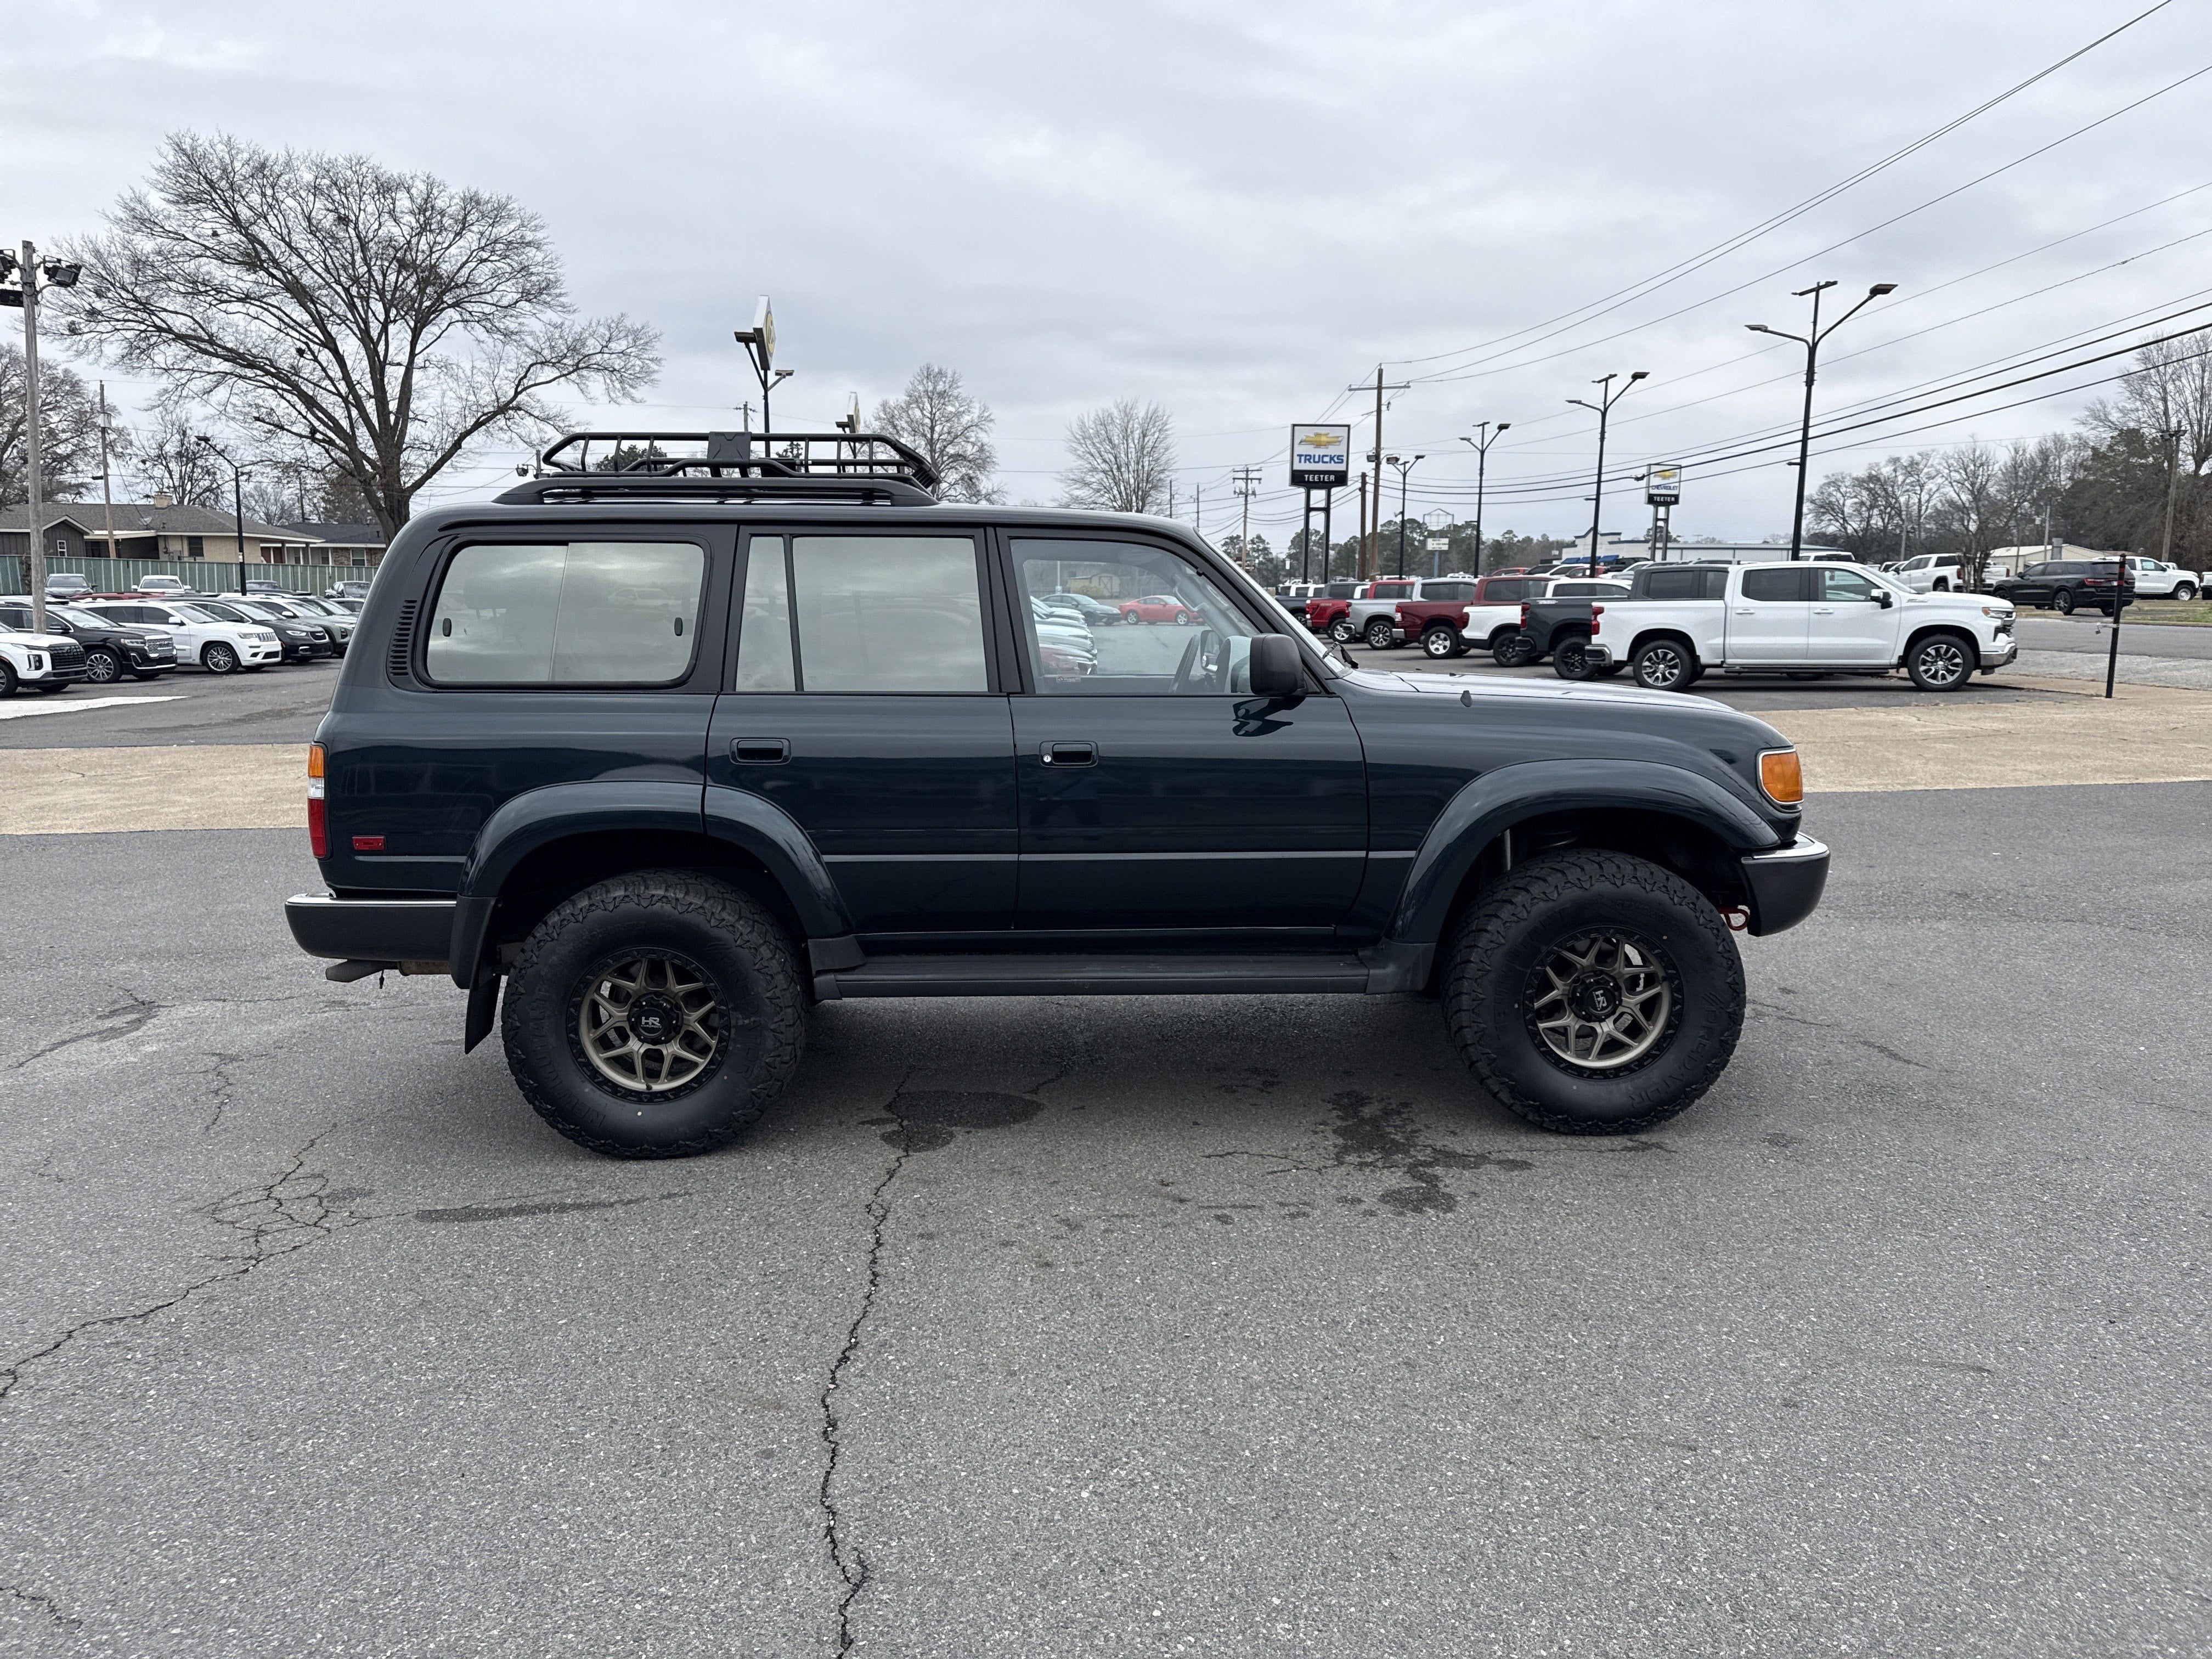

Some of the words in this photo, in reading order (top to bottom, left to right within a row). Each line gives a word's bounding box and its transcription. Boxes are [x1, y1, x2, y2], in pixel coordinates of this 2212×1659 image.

[1297, 454, 1344, 464] TRUCKS
[641, 1017, 661, 1026] HR
[1628, 1007, 1719, 1109] PREDATOR
